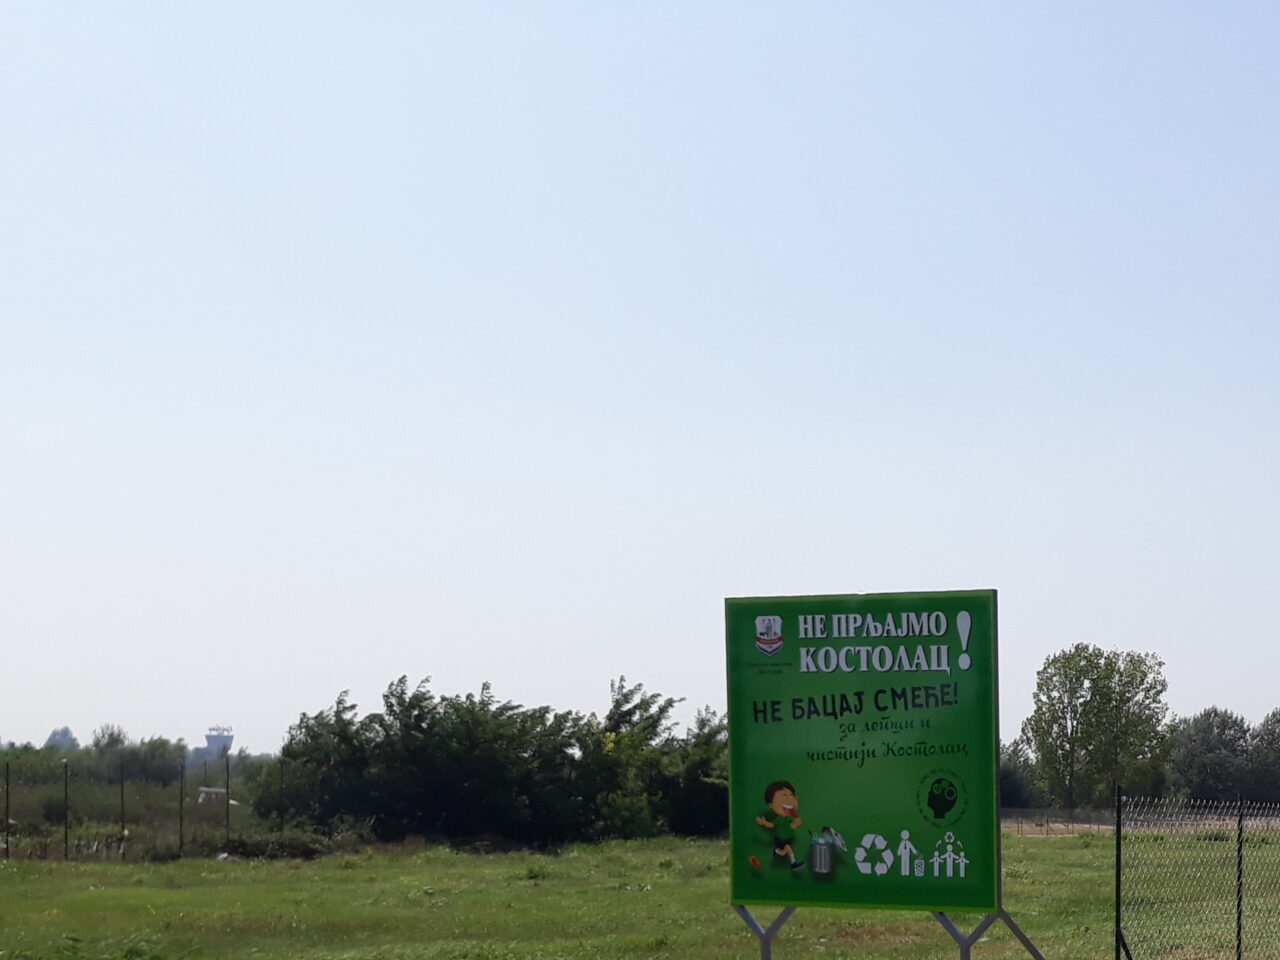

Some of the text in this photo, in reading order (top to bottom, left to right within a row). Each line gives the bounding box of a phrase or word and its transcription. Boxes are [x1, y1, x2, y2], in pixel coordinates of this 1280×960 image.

[798, 611, 948, 638] НЕ ПРЉАЈМО
[753, 682, 959, 723] НЕ БАЦАЈ СМЕЋЕ!
[839, 716, 931, 742] за лепши и
[807, 740, 969, 768] чистији Костолац
